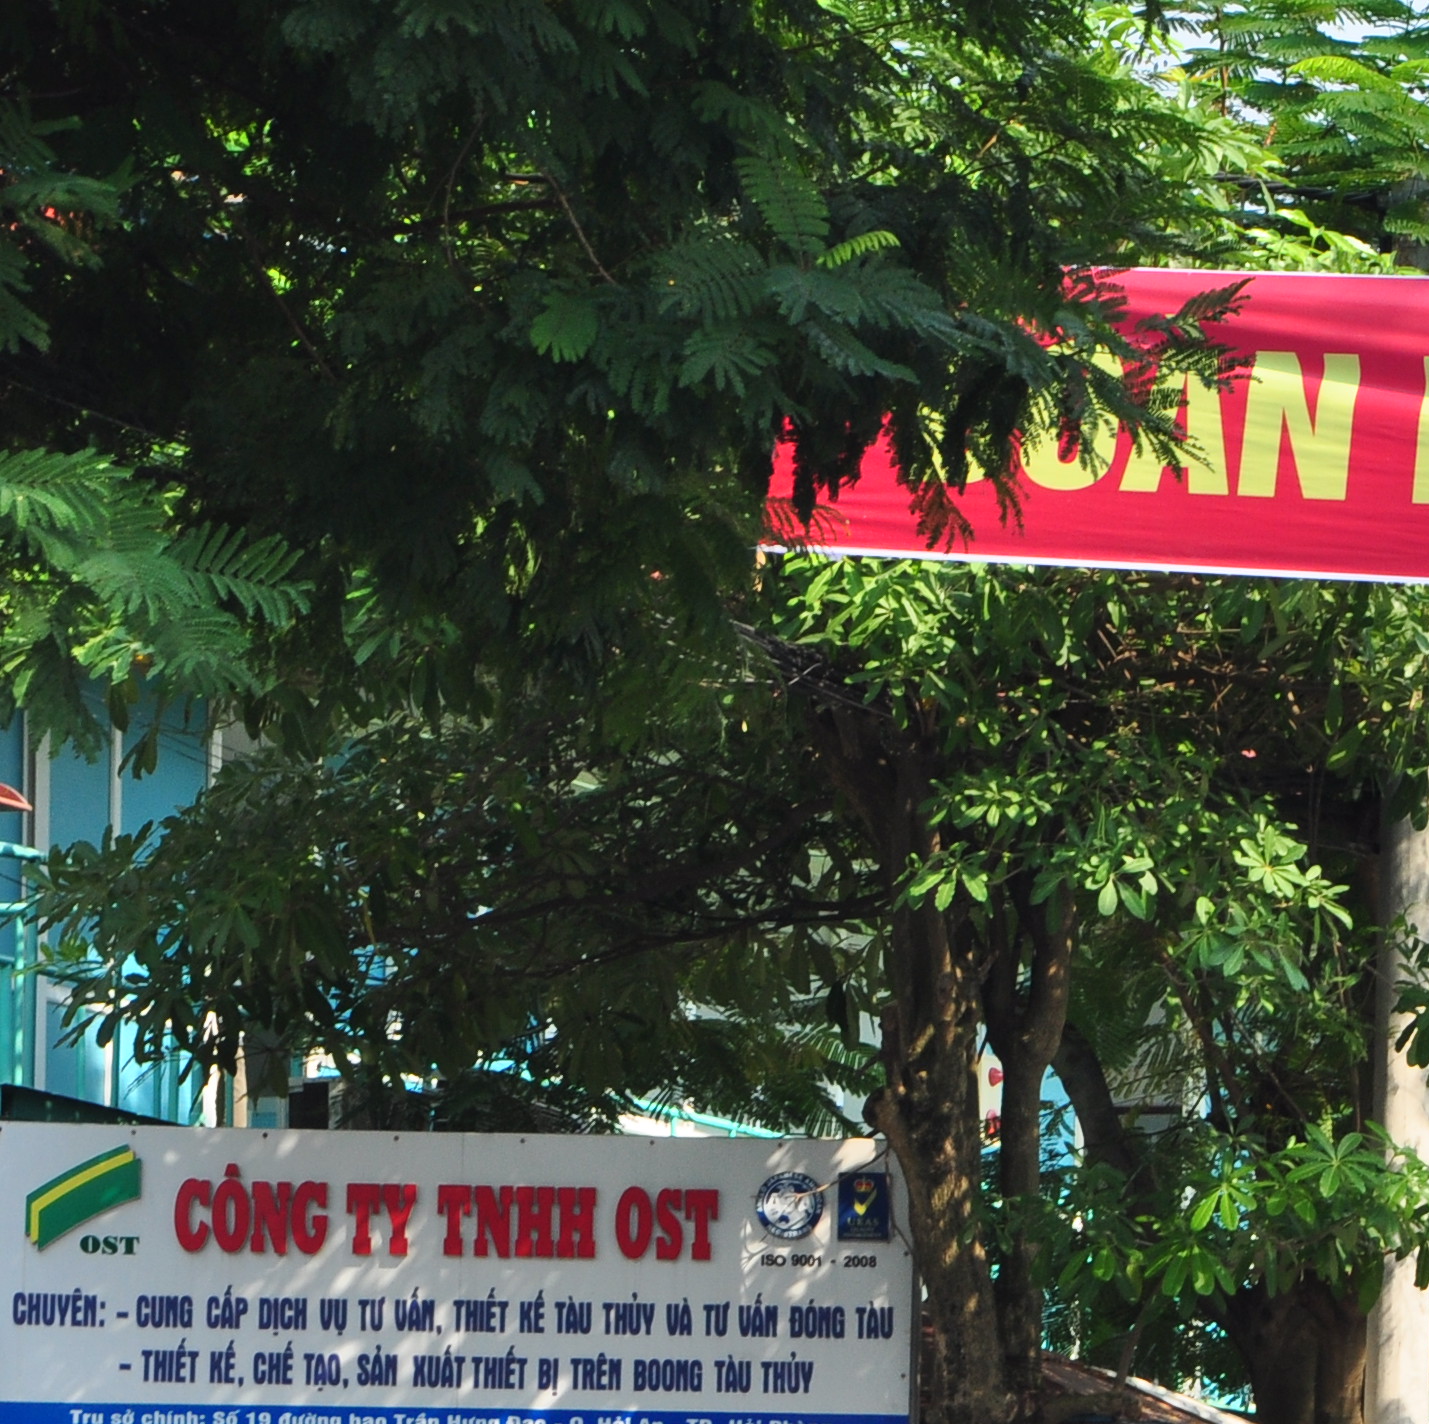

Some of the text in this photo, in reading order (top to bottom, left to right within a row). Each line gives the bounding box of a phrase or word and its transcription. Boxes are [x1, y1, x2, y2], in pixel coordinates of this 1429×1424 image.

[174, 1163, 329, 1255] CÔNG
[346, 1183, 417, 1256] TY
[437, 1184, 597, 1259] TNHH
[614, 1186, 719, 1261] OST
[79, 1235, 140, 1255] OST
[761, 1254, 786, 1267] ISO
[791, 1254, 822, 1268] 9001
[844, 1255, 877, 1268] 2008
[12, 1288, 106, 1327] CHUYÊN:
[136, 1295, 193, 1328] CUNG
[207, 1285, 249, 1329] CẤP
[258, 1297, 307, 1336] DỊCH
[320, 1298, 348, 1336] VỤ
[358, 1296, 386, 1331] TƯ
[394, 1286, 442, 1335] VẤN,
[453, 1287, 509, 1333] THIẾT
[519, 1289, 545, 1333] KẾ
[554, 1295, 592, 1335] TÀU
[602, 1291, 655, 1335] THỦY
[666, 1297, 692, 1336] VÀ
[703, 1301, 730, 1337] TƯ
[738, 1292, 778, 1338] VẤN
[789, 1298, 845, 1339] ĐÓNG
[855, 1300, 894, 1340] TÀU
[141, 1337, 199, 1383] THIẾT
[209, 1339, 244, 1388] KẾ,
[253, 1340, 293, 1385] CHẾ
[303, 1353, 349, 1392] TẠO,
[357, 1344, 398, 1387] SẢN
[413, 1344, 465, 1389] XUẤT
[472, 1345, 527, 1390] THIẾT
[538, 1357, 559, 1396] BỊ
[570, 1352, 622, 1391] TRÊN
[633, 1358, 703, 1392] BOONG
[714, 1354, 752, 1393] TÀU
[761, 1351, 814, 1394] THỦY
